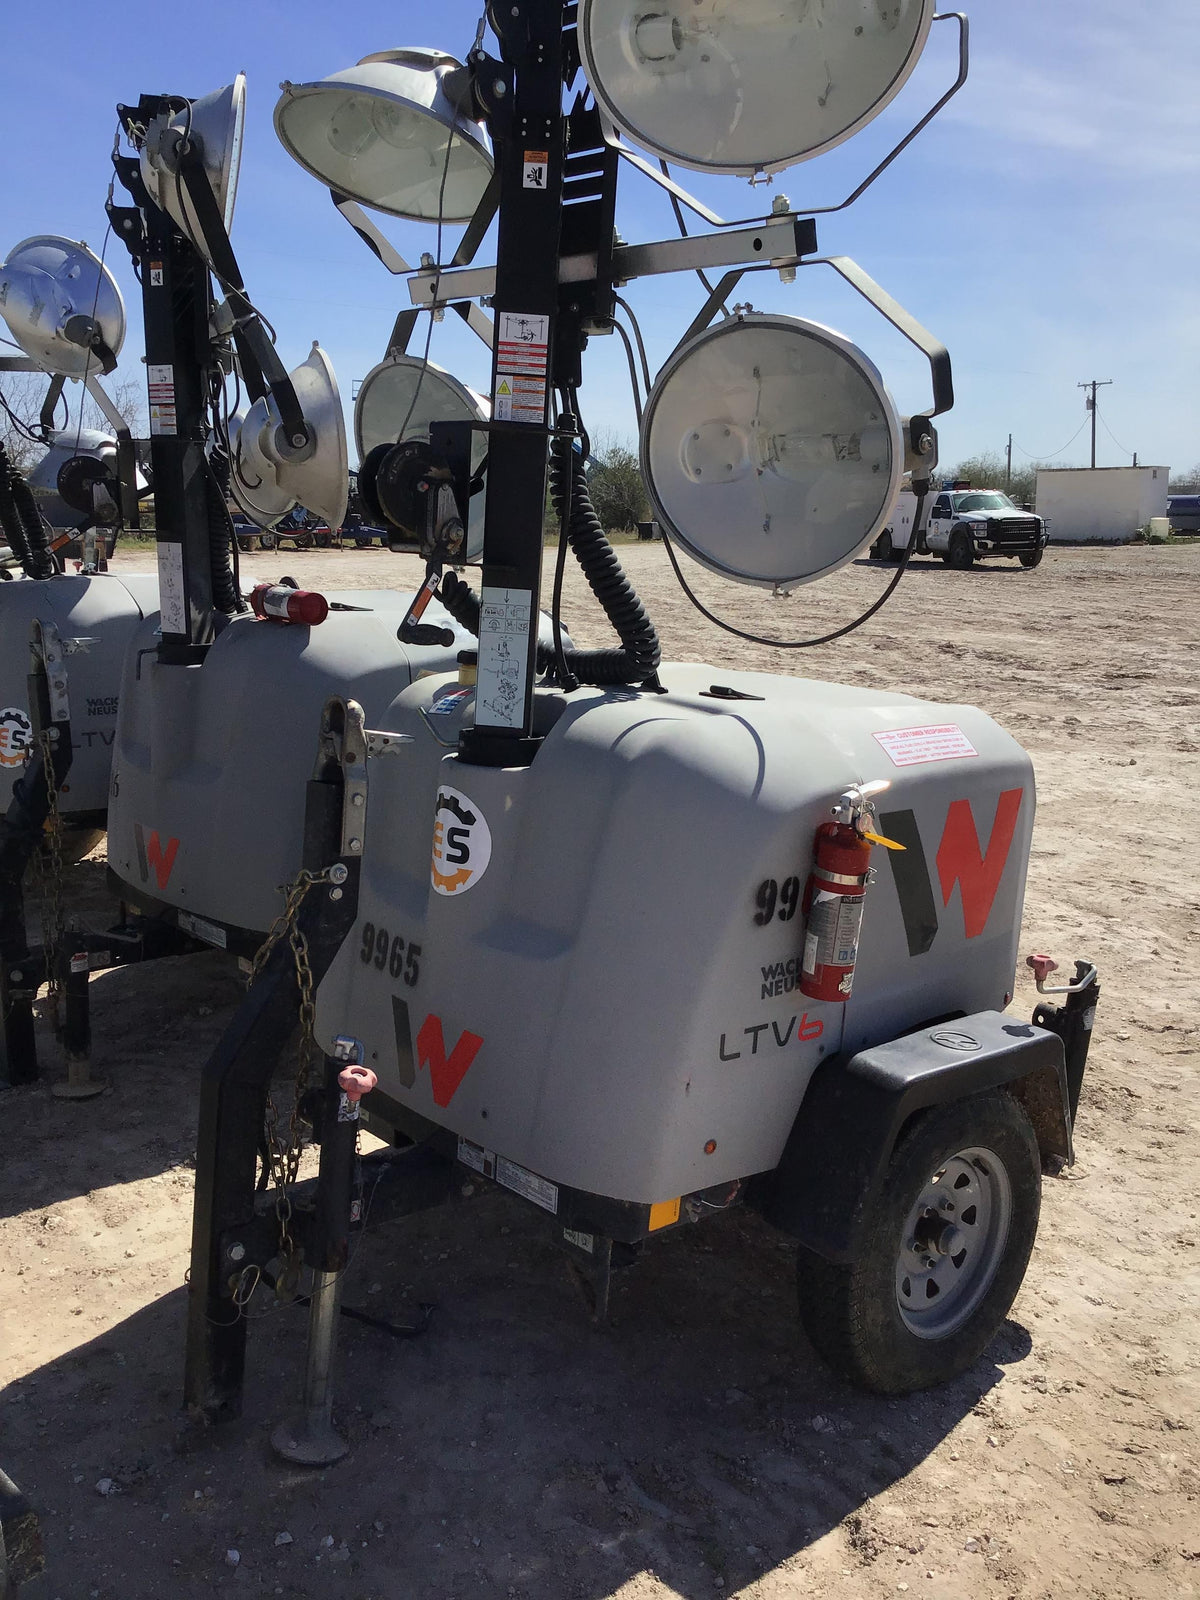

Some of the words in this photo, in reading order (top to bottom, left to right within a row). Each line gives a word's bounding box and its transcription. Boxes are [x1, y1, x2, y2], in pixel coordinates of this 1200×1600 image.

[87, 706, 118, 716] NEUS
[897, 730, 924, 738] CUSTOMER
[360, 922, 421, 986] 9965
[720, 1013, 824, 1061] LTV6
